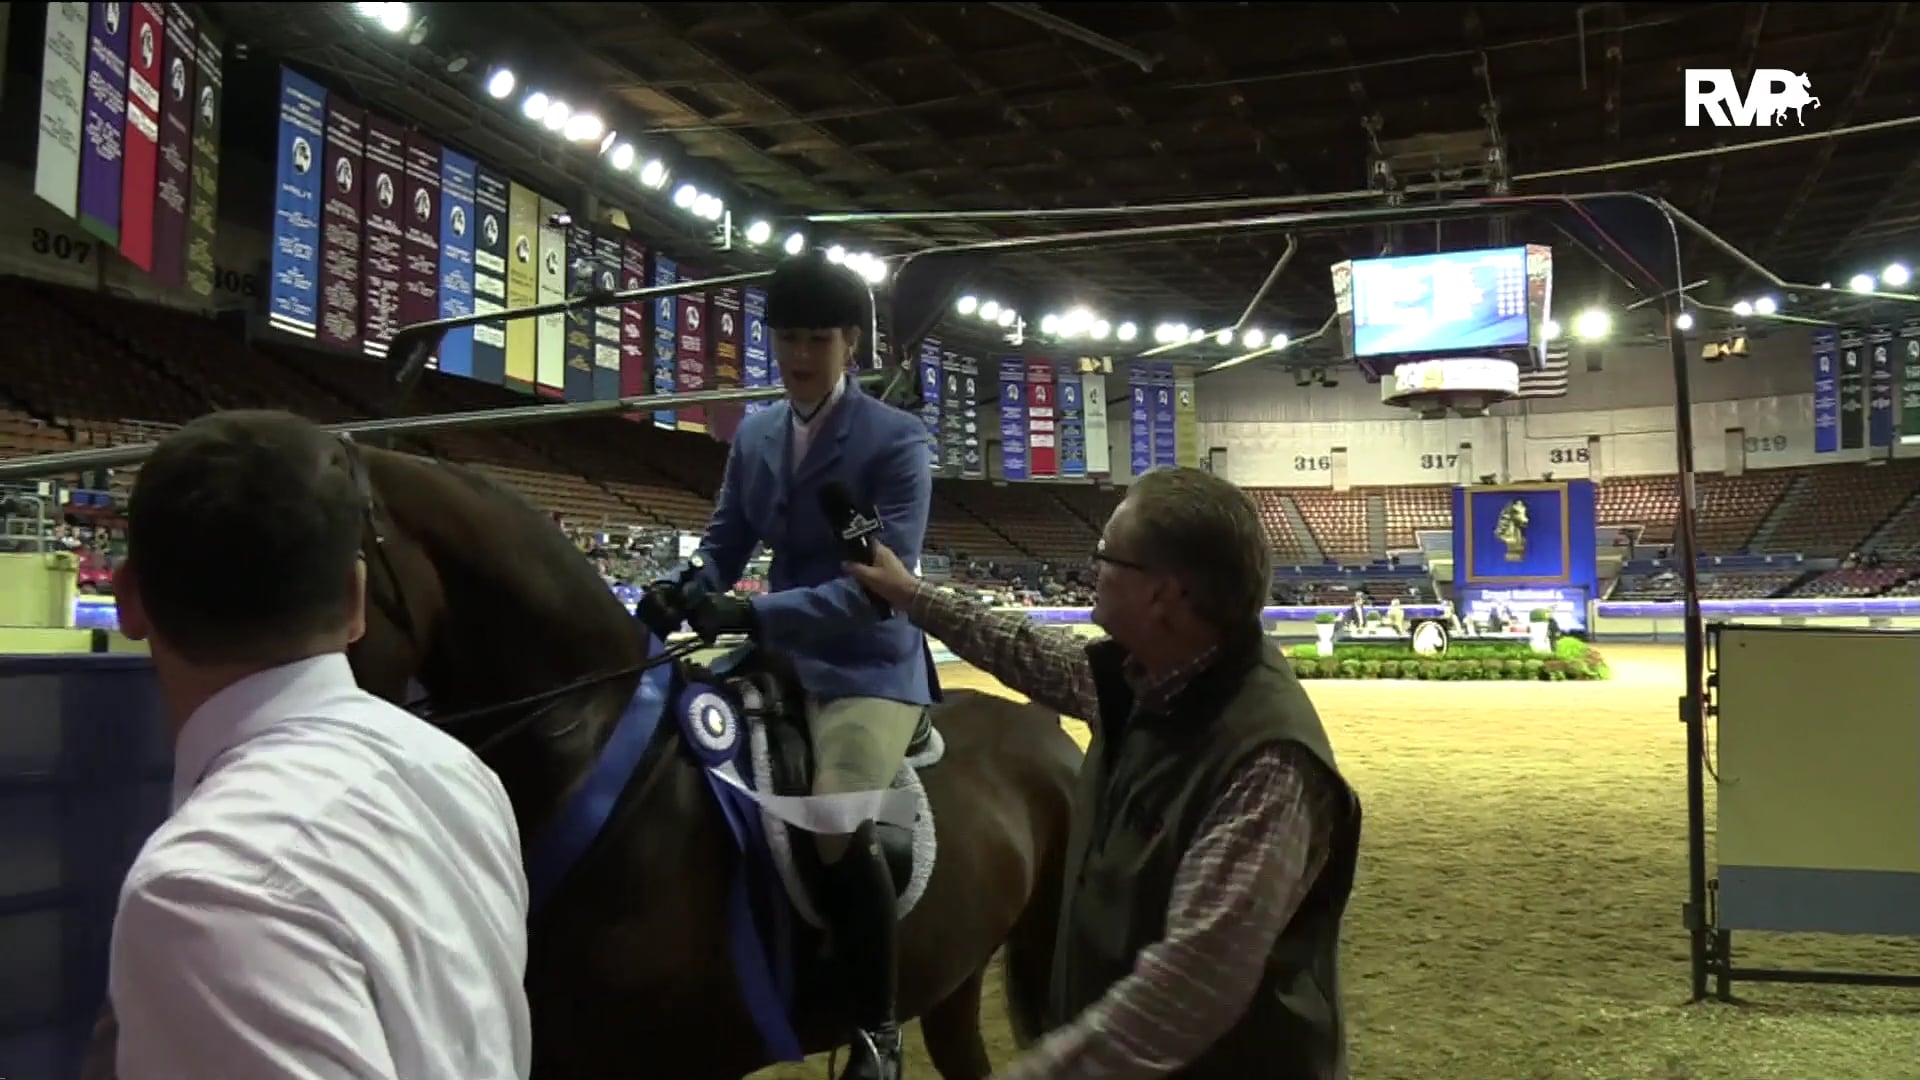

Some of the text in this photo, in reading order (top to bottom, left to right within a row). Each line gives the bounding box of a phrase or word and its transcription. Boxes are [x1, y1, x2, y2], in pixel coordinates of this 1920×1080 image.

[32, 228, 90, 263] 307
[1421, 454, 1459, 469] 317
[1550, 448, 1590, 463] 318
[1294, 456, 1331, 471] 316
